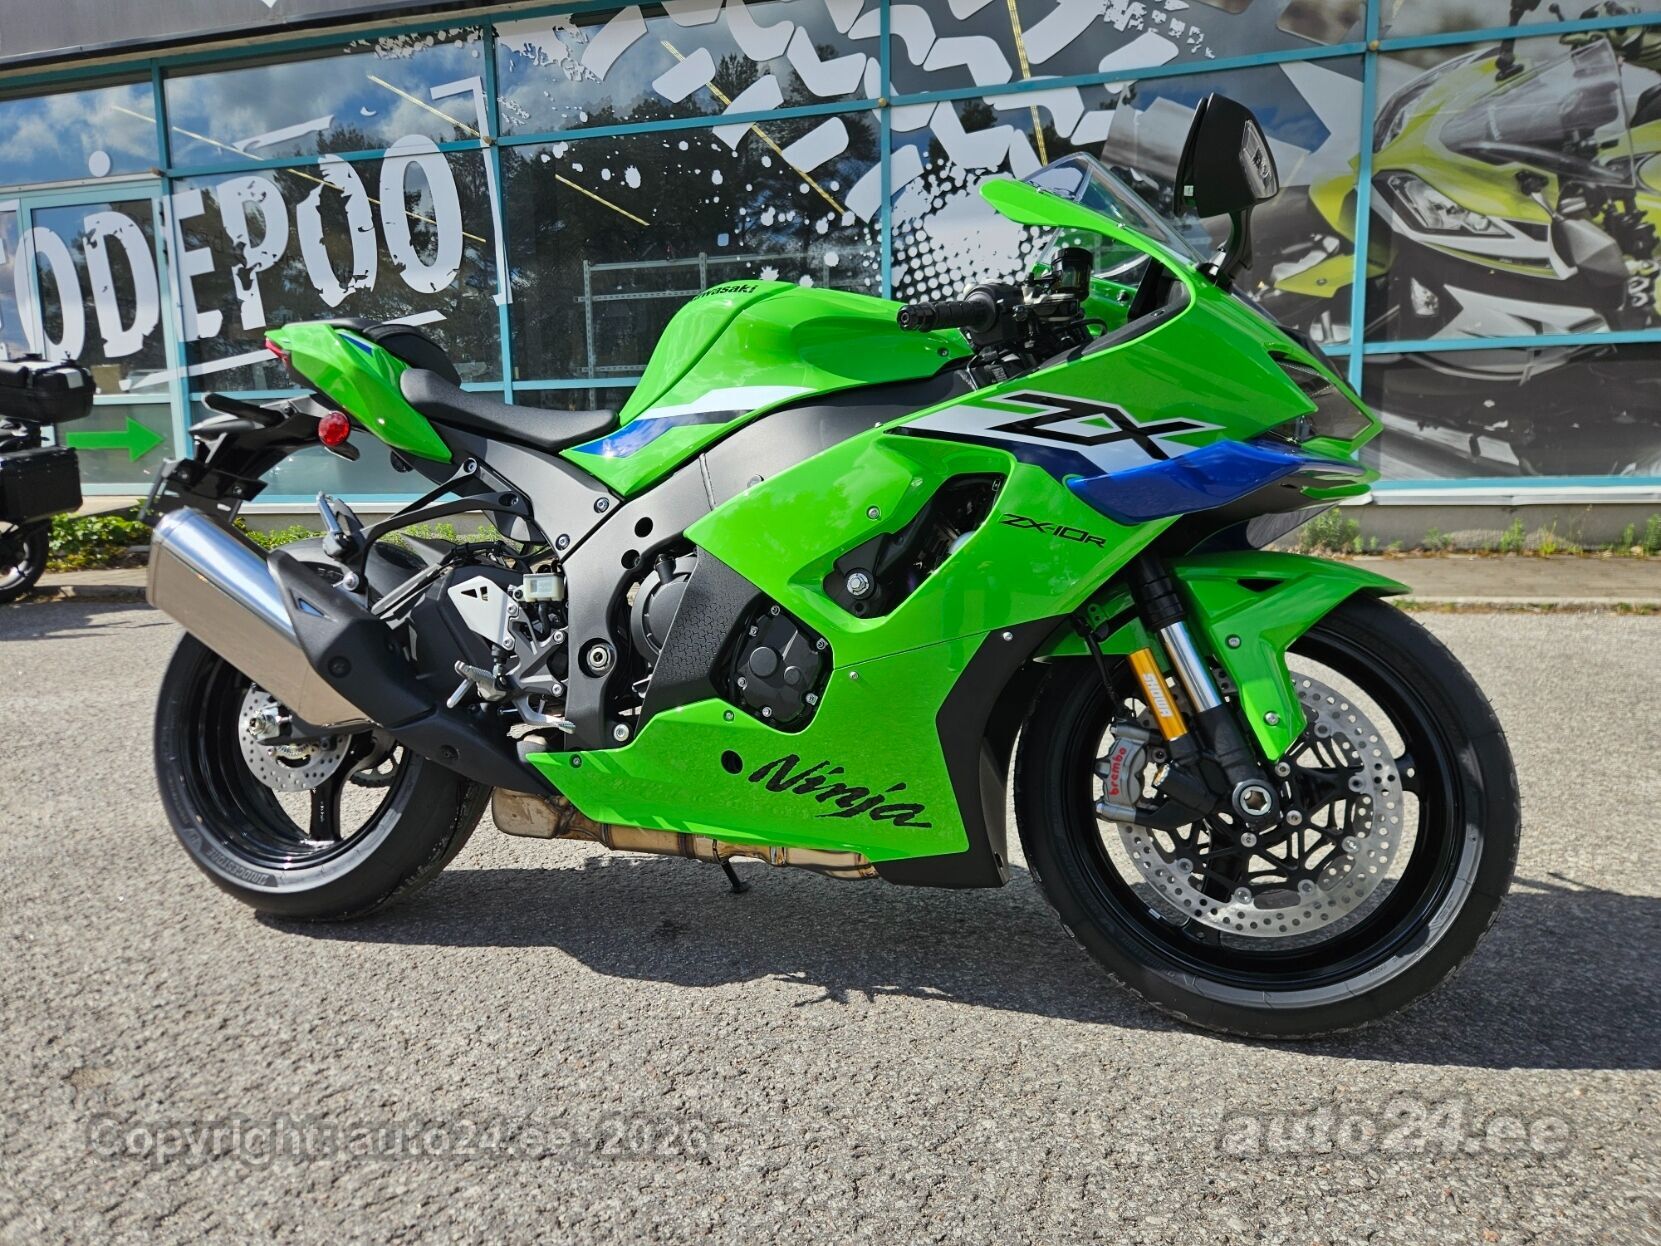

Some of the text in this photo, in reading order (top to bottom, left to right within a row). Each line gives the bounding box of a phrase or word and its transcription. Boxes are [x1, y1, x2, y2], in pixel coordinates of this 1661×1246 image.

[0, 134, 463, 362] ODEPOO
[692, 284, 759, 300] wasaki
[1001, 513, 1107, 549] ZX-10R
[748, 754, 932, 828] Ninja
[1109, 747, 1127, 796] brembo
